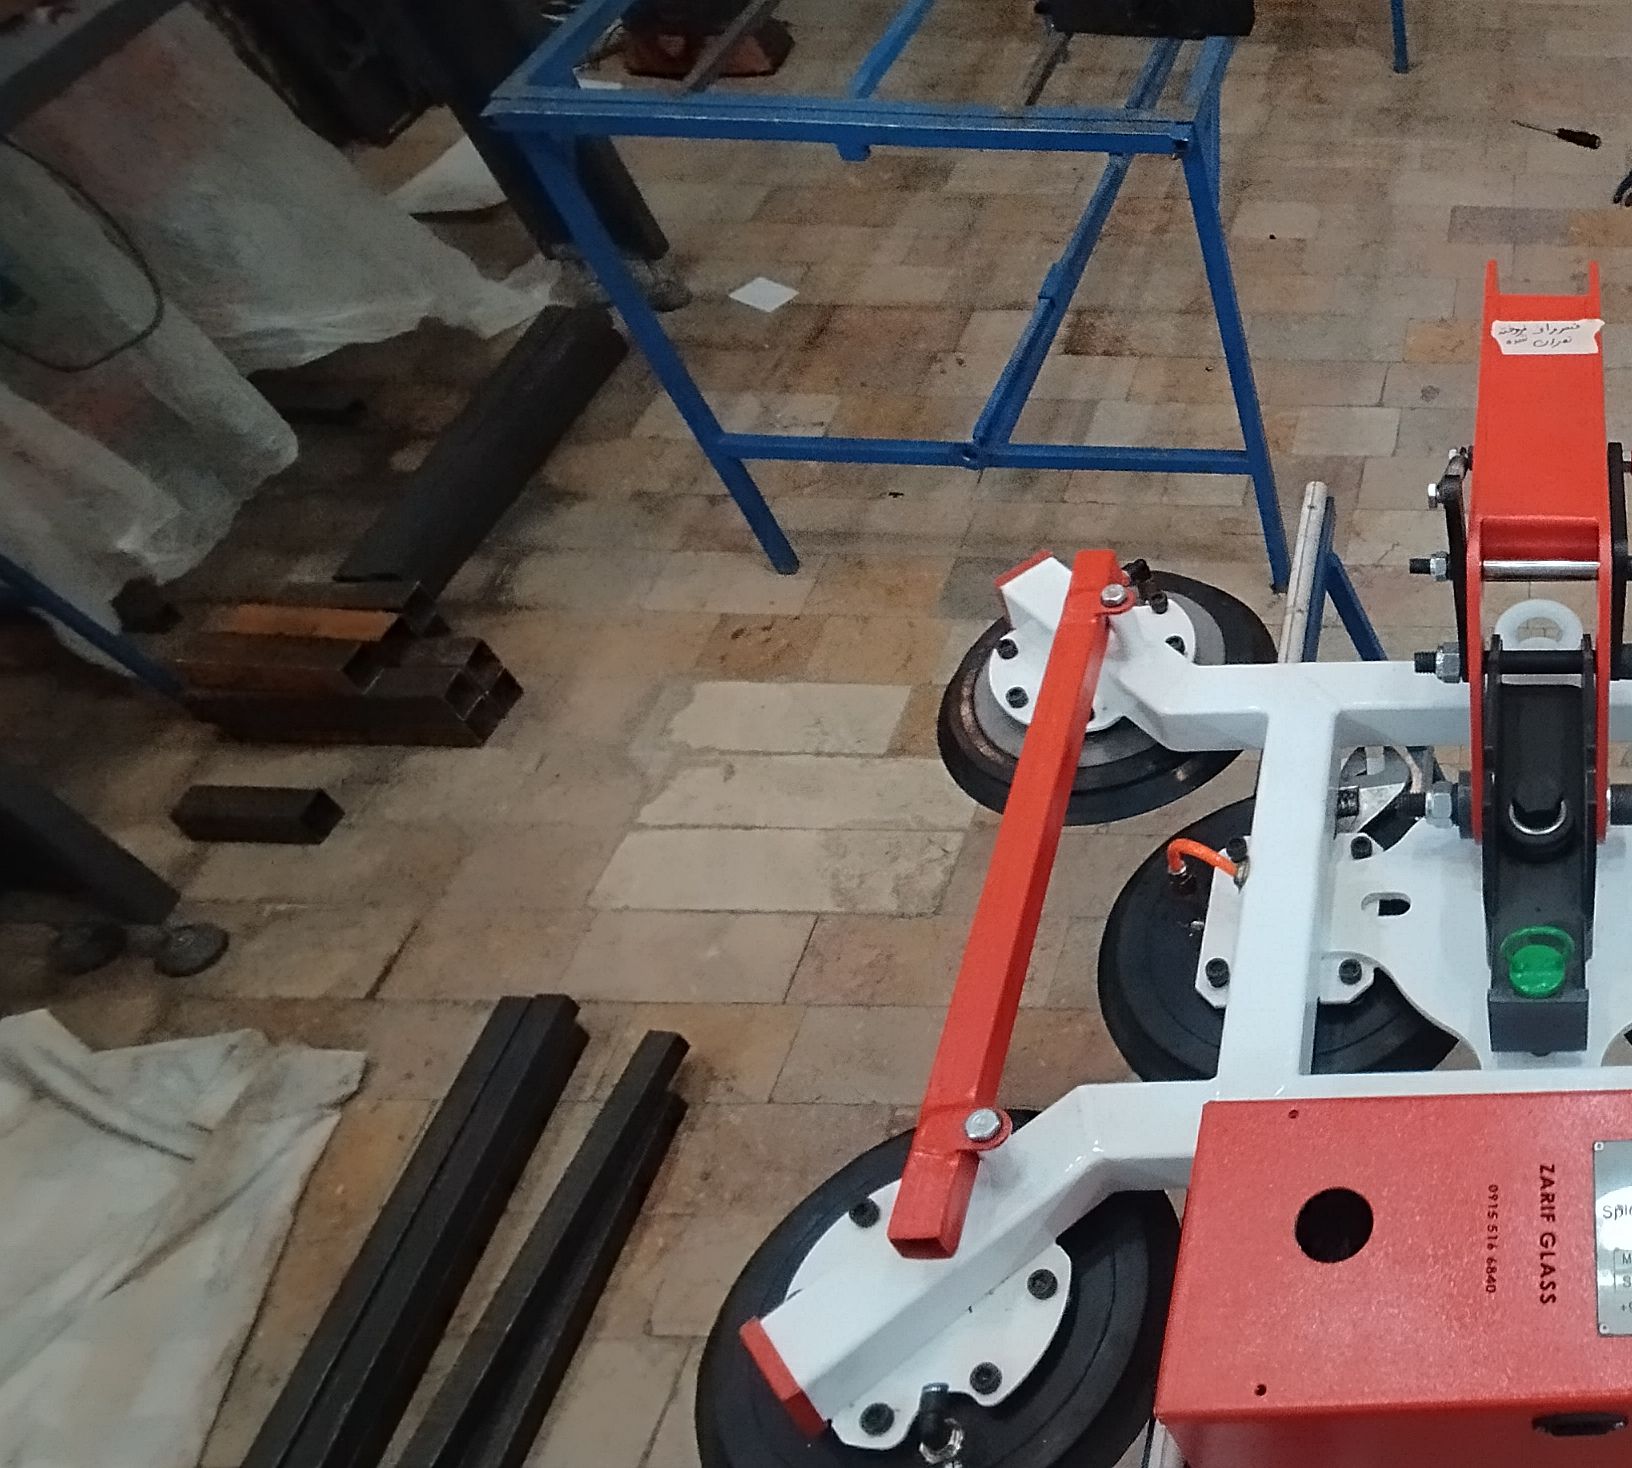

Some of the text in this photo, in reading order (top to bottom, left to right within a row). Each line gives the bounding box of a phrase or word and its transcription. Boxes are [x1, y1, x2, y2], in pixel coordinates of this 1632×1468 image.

[1485, 1184, 1499, 1294] 0915 516 6840
[1539, 1164, 1557, 1305] ZARIF GLASS
